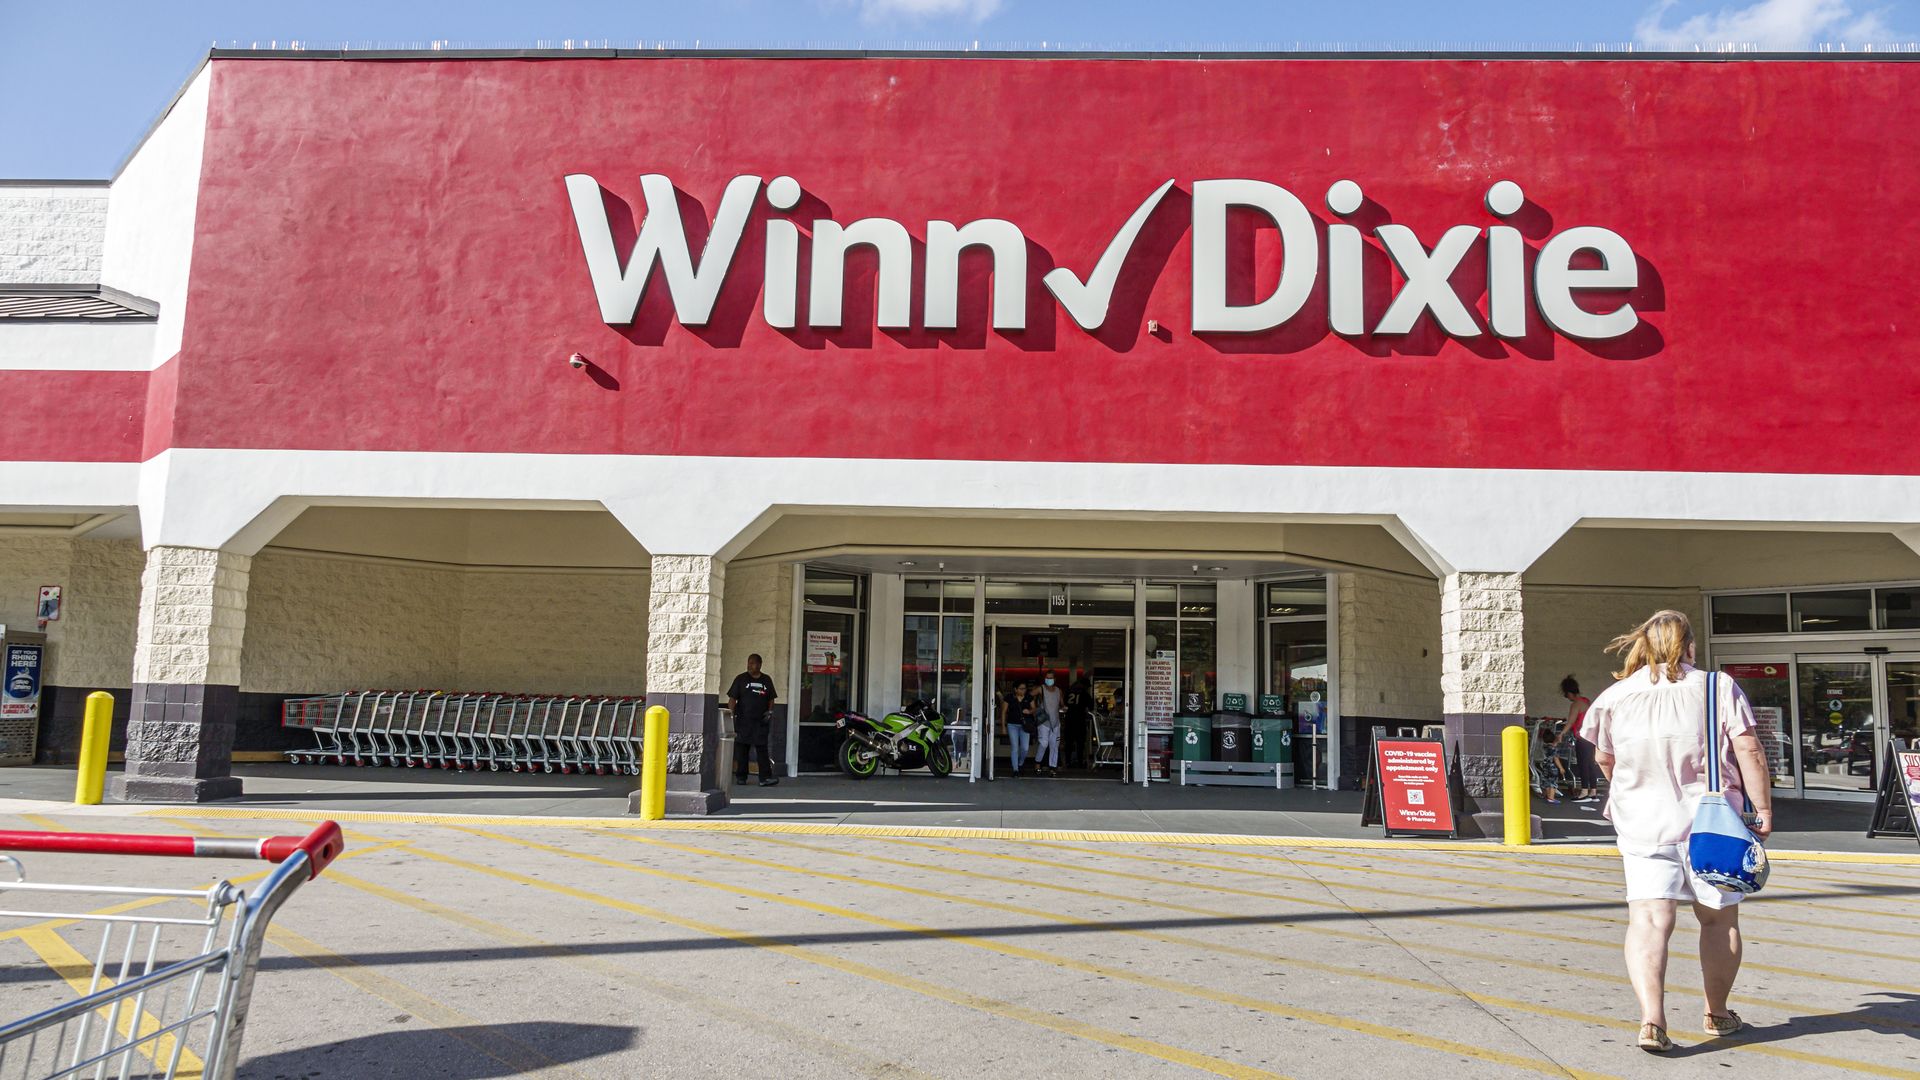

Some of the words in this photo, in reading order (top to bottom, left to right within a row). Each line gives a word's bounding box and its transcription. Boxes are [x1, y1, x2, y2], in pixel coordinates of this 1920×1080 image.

[565, 174, 1027, 330] Winn
[1191, 179, 1639, 340] Dixie
[1052, 595, 1065, 606] 1155
[1068, 693, 1079, 704] 21
[1427, 758, 1436, 766] by
[1425, 765, 1439, 773] only
